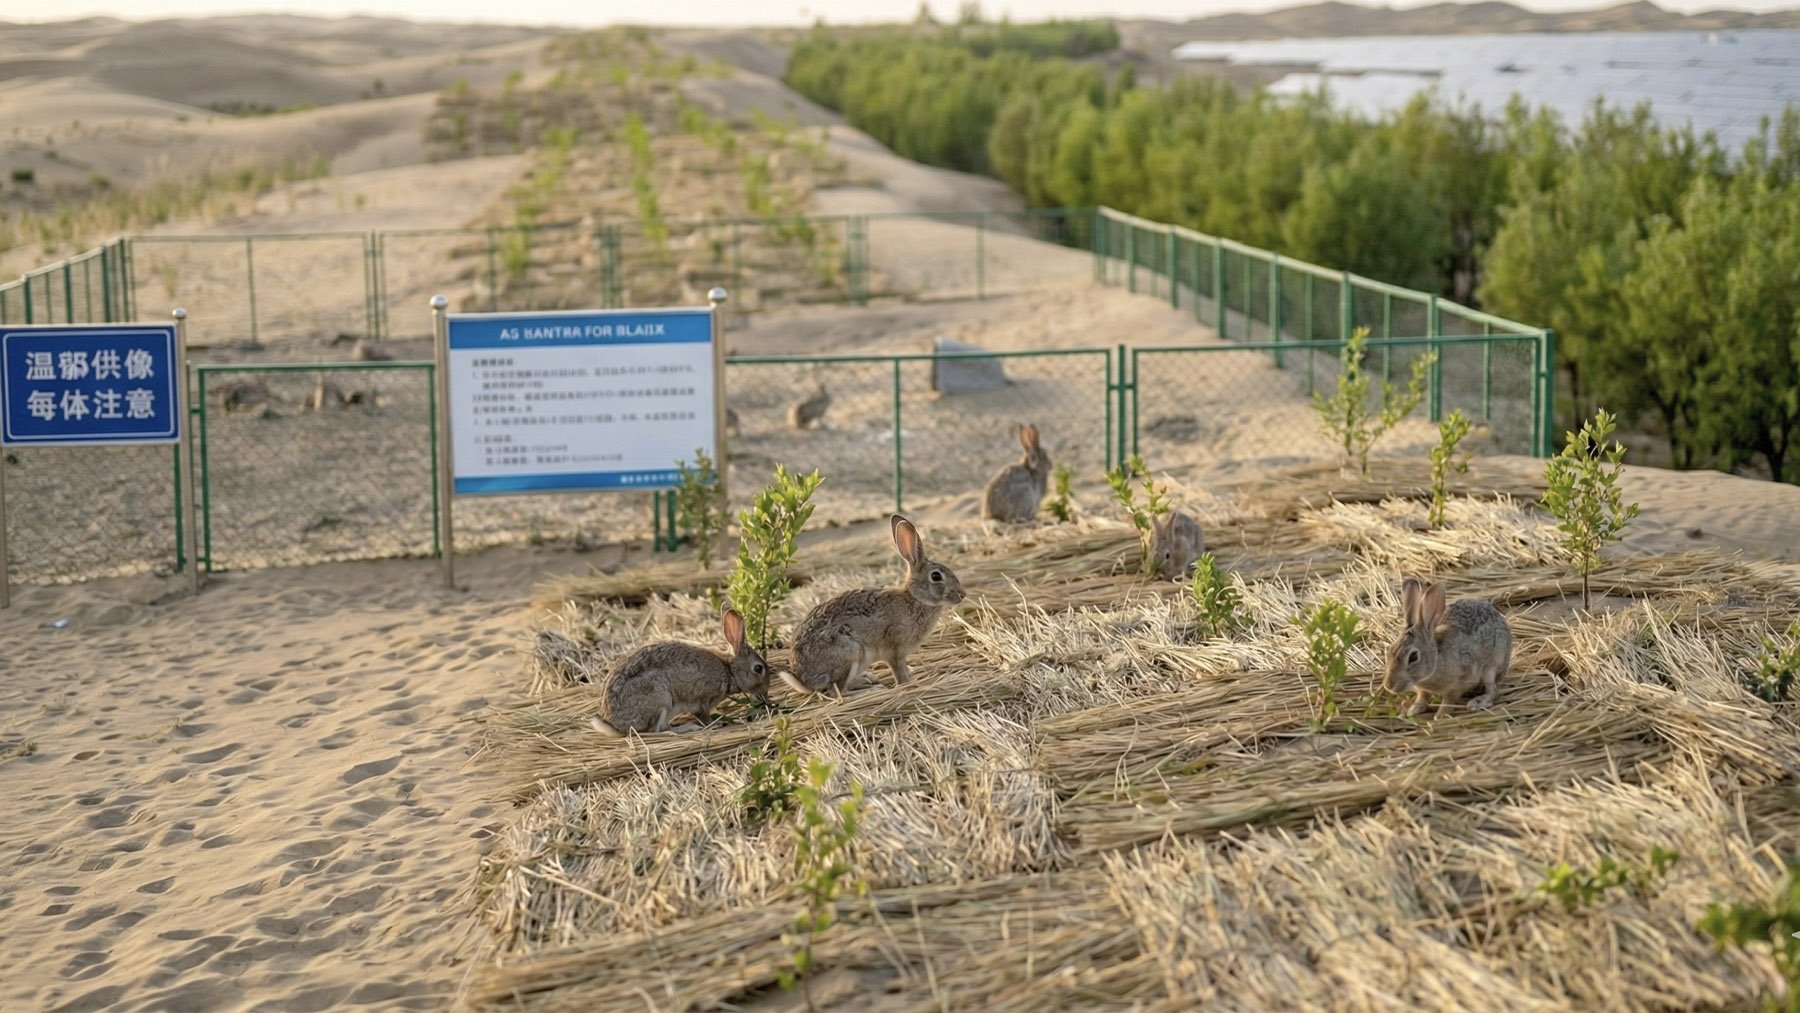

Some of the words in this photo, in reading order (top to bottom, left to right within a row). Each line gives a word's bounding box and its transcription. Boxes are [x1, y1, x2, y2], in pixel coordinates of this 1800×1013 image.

[585, 325, 612, 338] FOR
[26, 387, 155, 421] 每体注意
